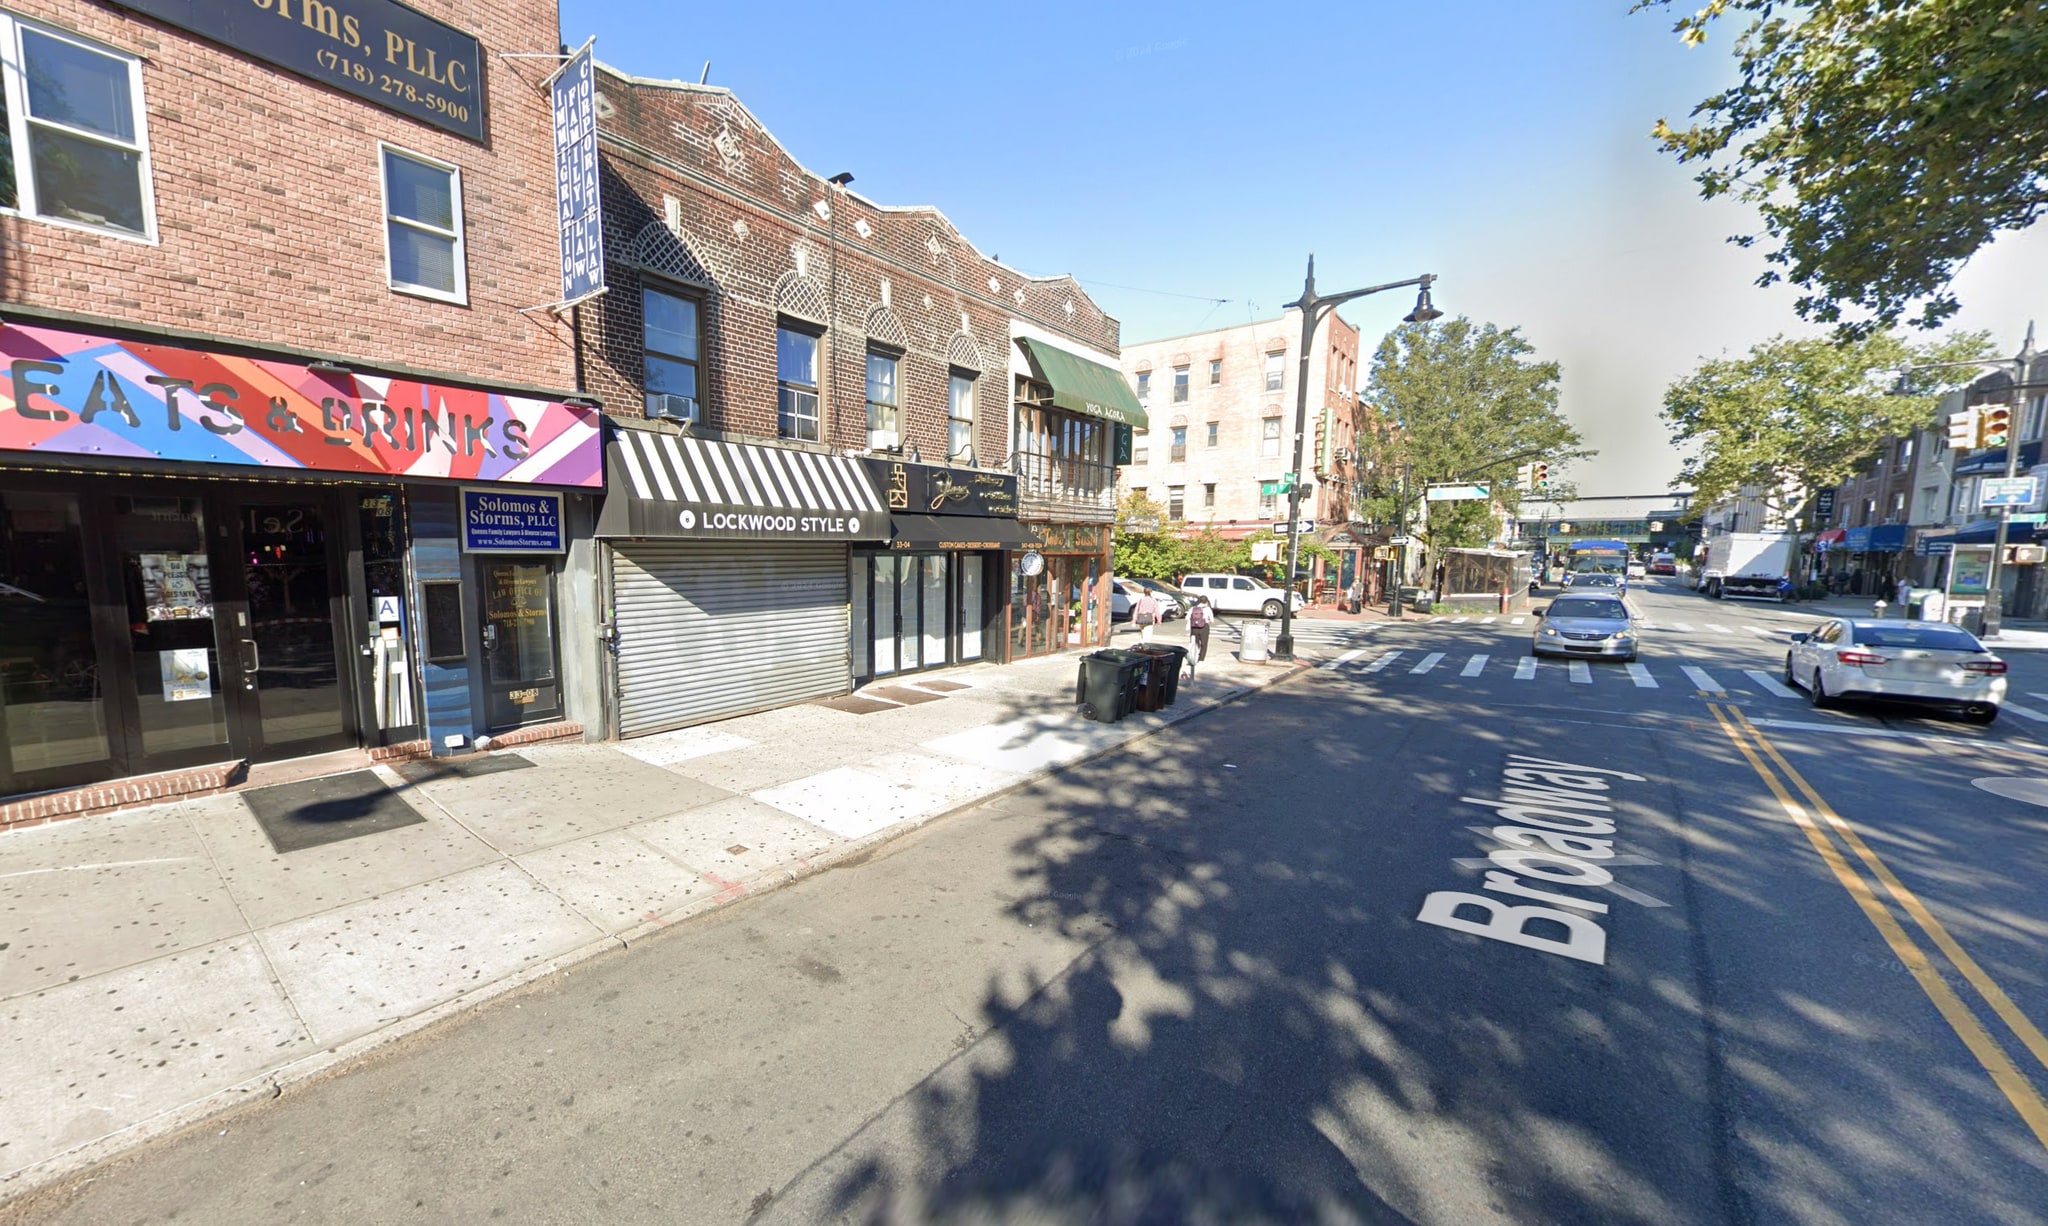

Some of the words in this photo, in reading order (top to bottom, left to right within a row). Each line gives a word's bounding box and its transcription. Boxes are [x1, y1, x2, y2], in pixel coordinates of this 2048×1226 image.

[384, 28, 468, 93] PLLC
[316, 49, 374, 86] (718)
[380, 74, 469, 123] 278-5900
[568, 86, 582, 203] FAMILY
[555, 88, 573, 292] IMMIGRATION
[574, 219, 586, 277] LAW
[588, 235, 600, 286] LAW
[11, 359, 245, 436] EATS
[266, 396, 304, 434] &
[321, 396, 530, 461] DRINKS
[470, 510, 525, 528] Storms,
[527, 516, 557, 527] PLLC
[478, 496, 536, 514] Solomos
[539, 500, 550, 514] &
[703, 512, 797, 532] LOCKWOOD
[800, 517, 845, 533] STYLE
[477, 538, 552, 547] www.SolomosStorms.com
[896, 541, 911, 549] 33-04
[380, 600, 394, 614] A
[488, 609, 517, 621] Solomos
[518, 608, 524, 618] &
